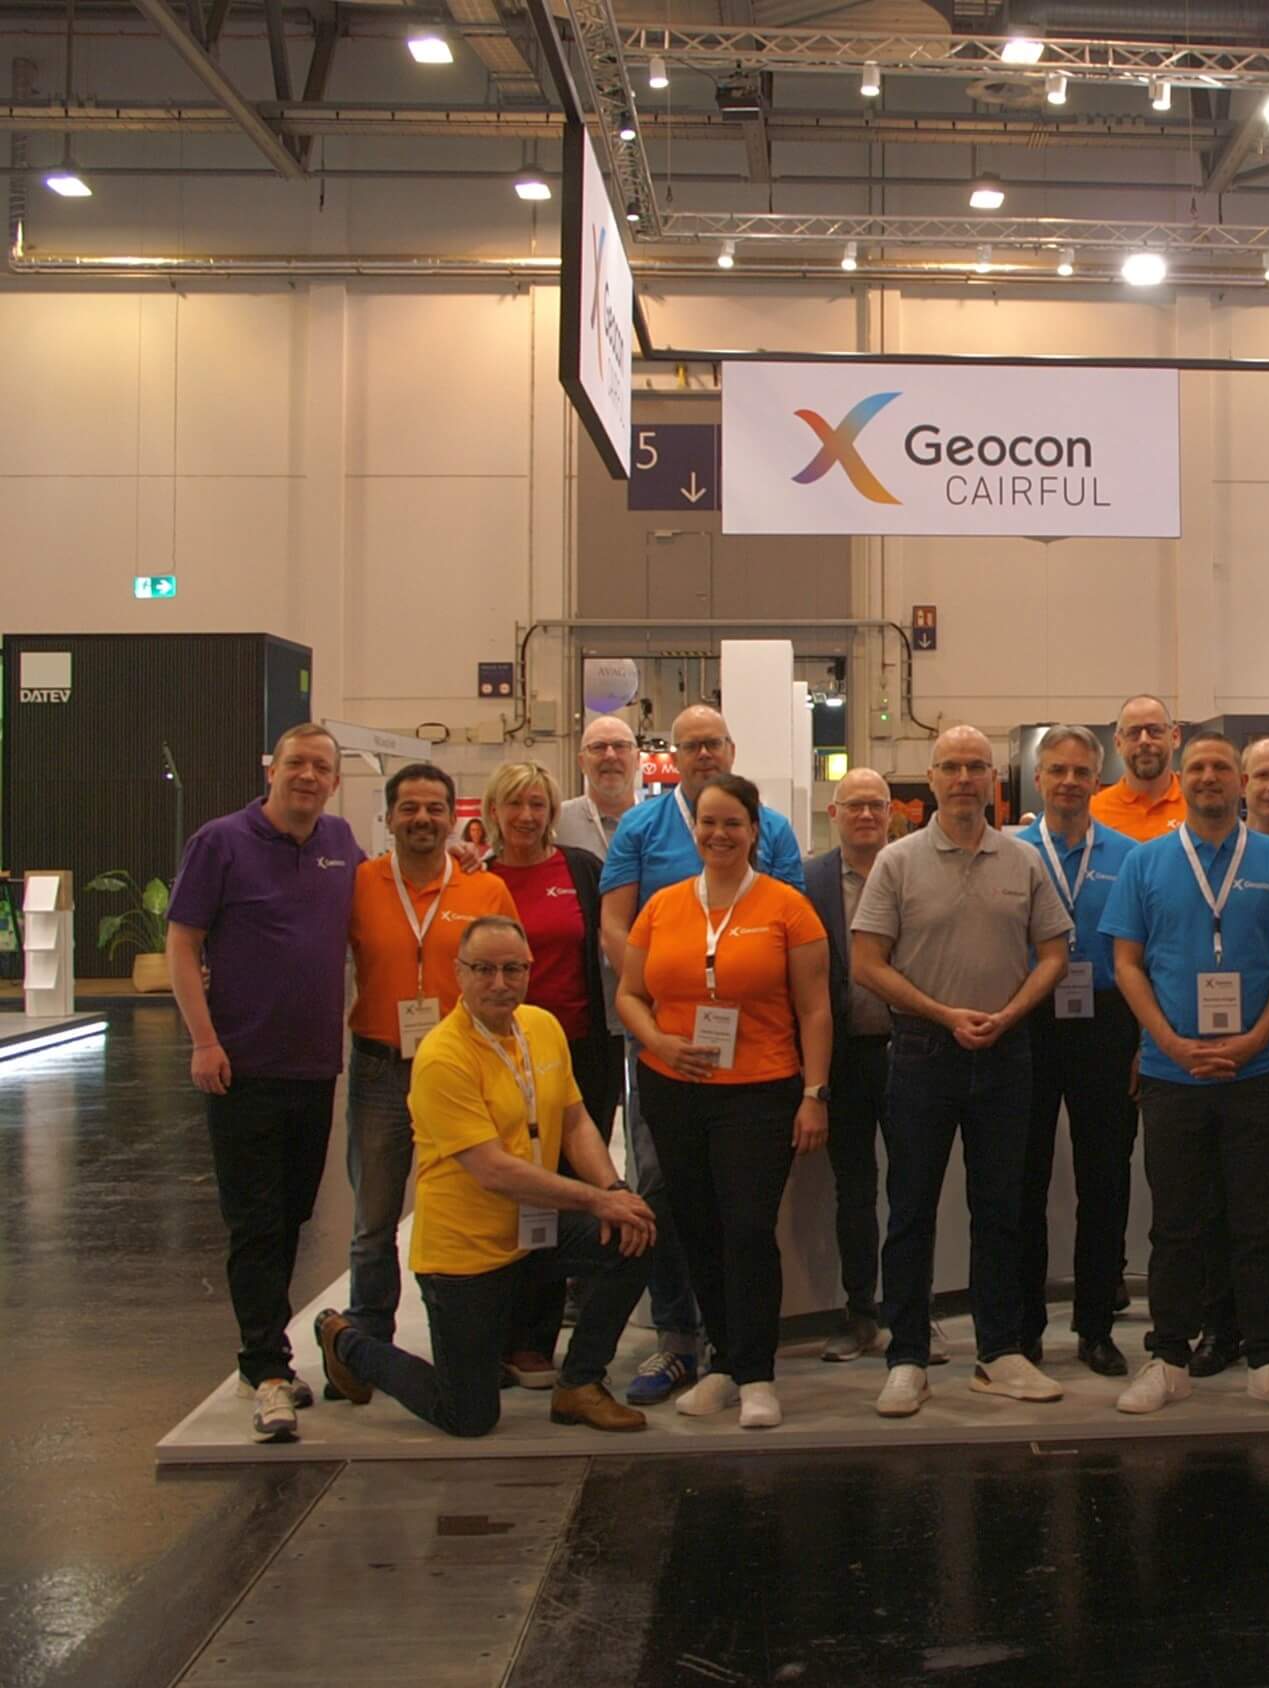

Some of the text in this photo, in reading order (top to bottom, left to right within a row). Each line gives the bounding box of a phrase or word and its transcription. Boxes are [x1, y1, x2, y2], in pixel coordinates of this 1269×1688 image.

[636, 432, 658, 470] 5
[904, 425, 1093, 468] Geocon
[946, 476, 1111, 507] CAIRFUL
[20, 690, 71, 703] DATEV
